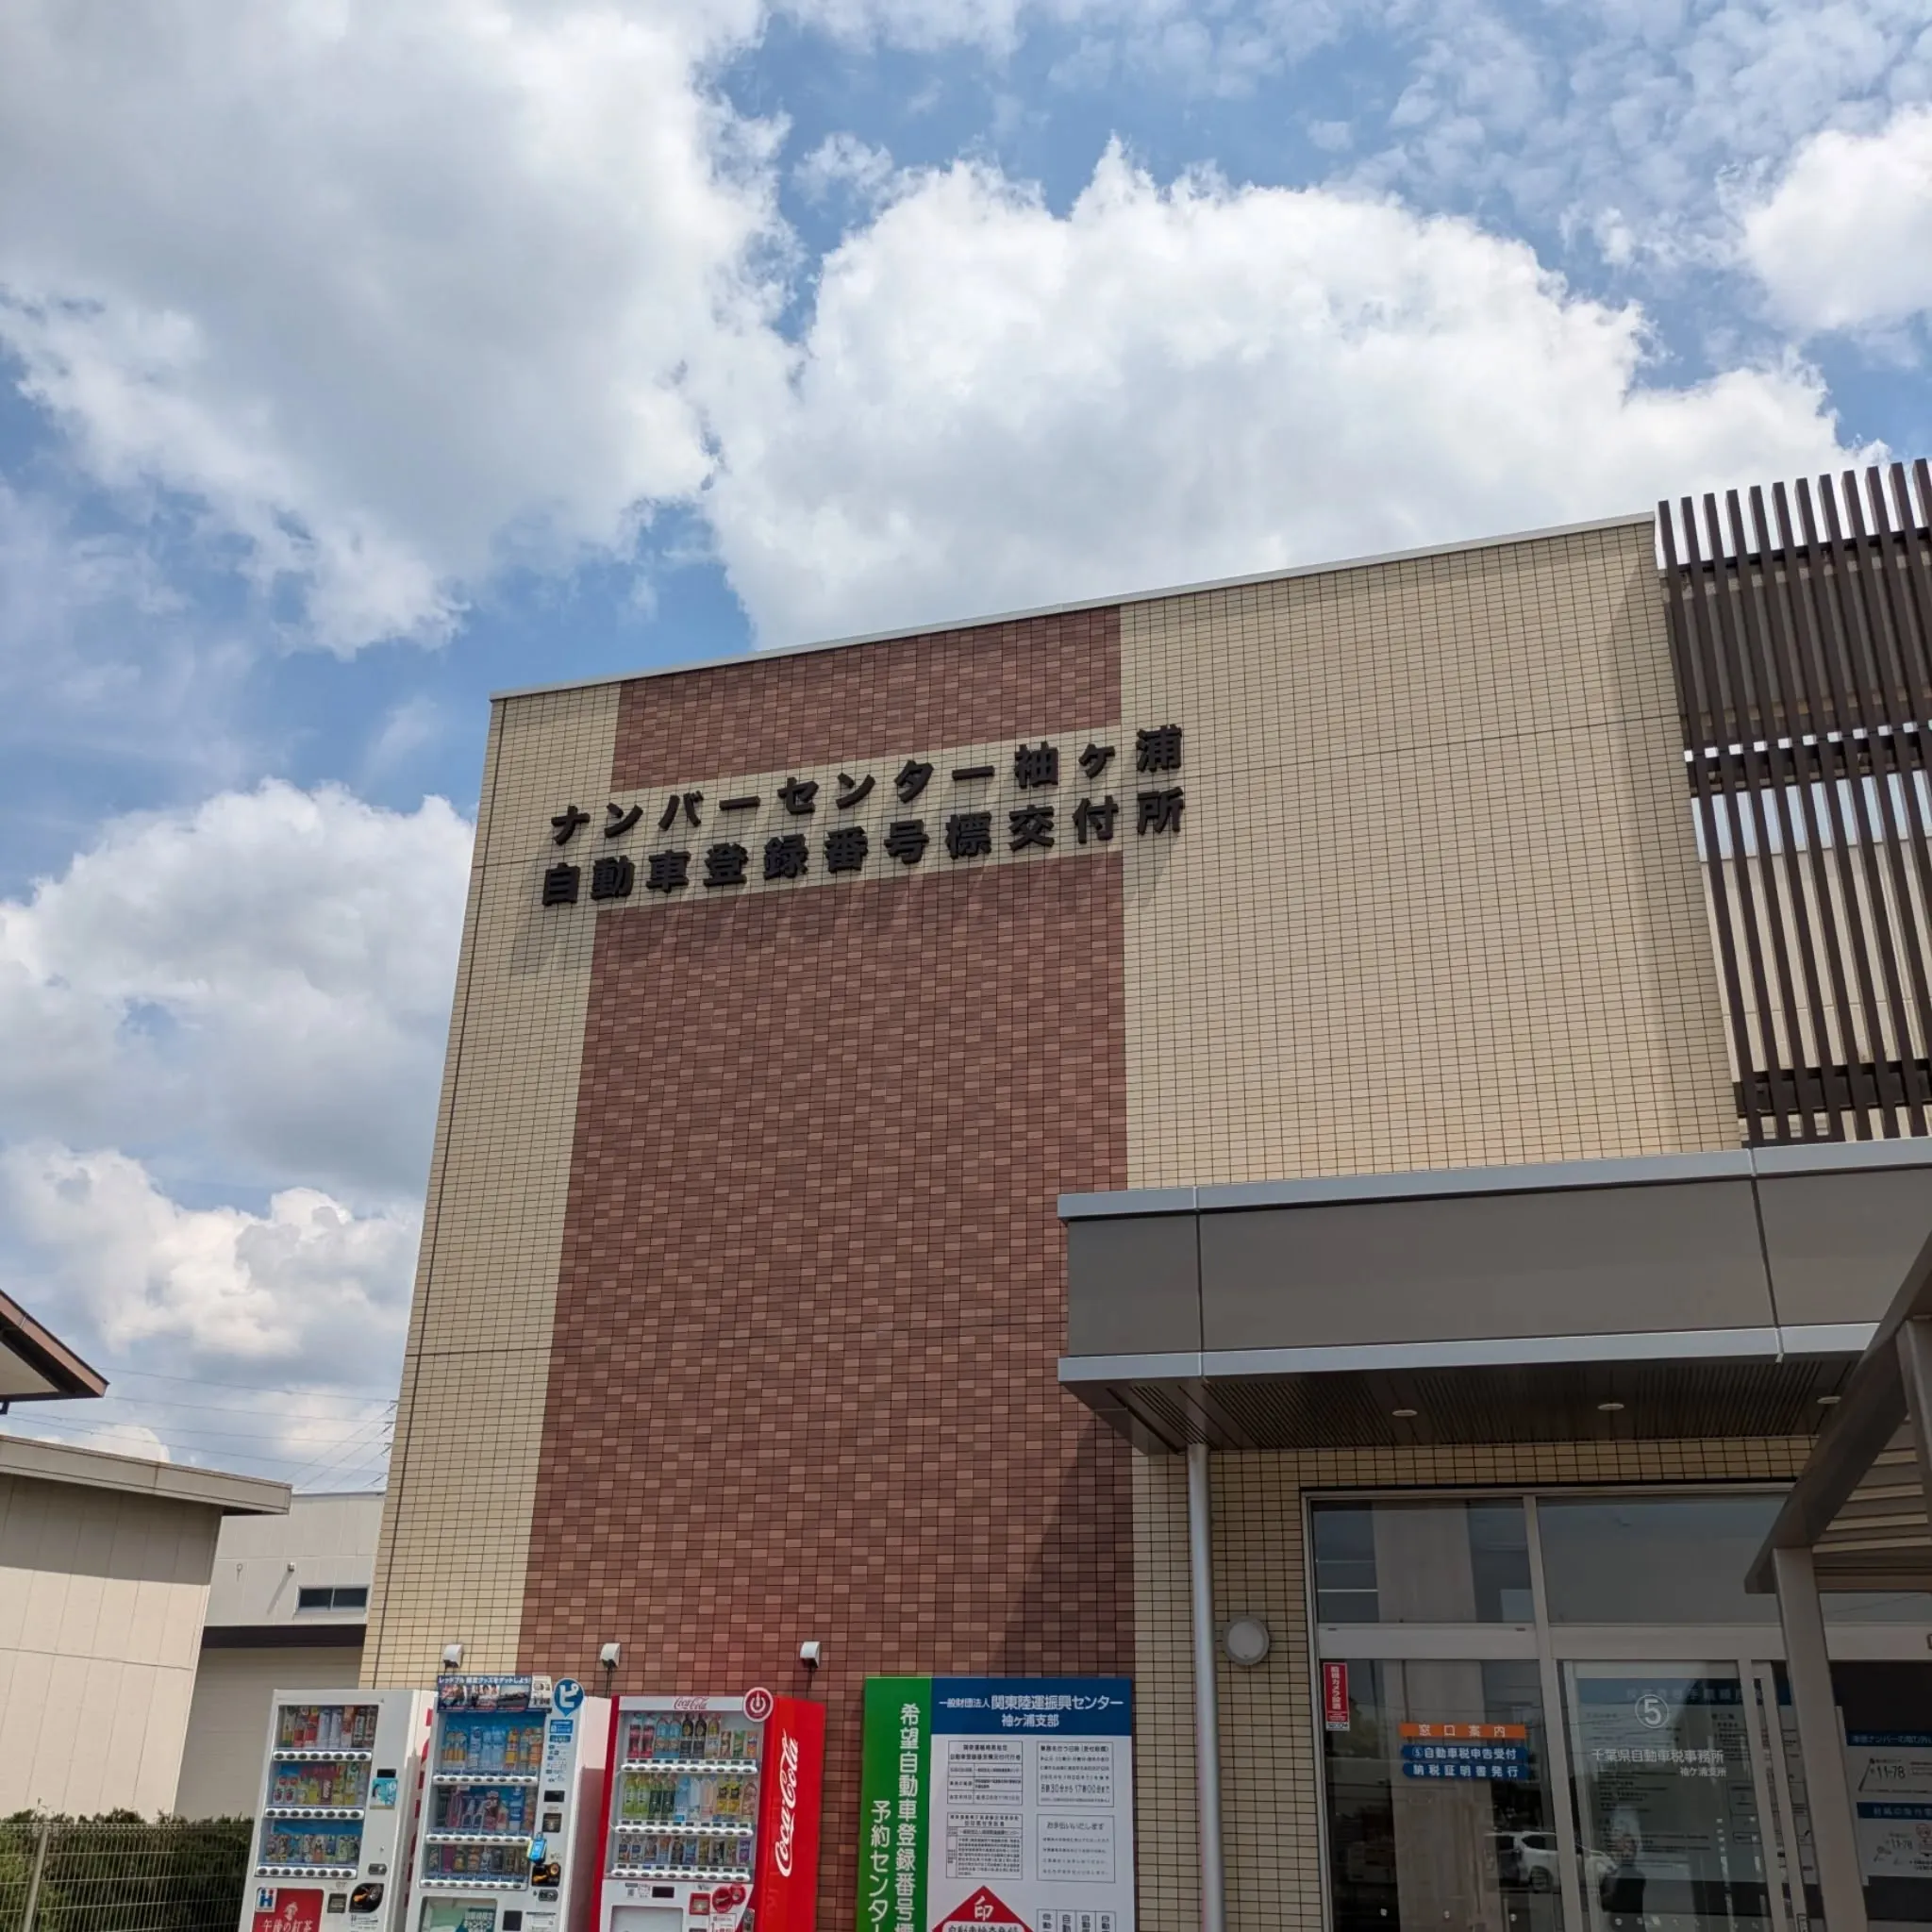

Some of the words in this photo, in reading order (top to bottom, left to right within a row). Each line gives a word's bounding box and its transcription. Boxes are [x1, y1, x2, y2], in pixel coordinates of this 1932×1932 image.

[542, 787, 1186, 907] 自動車登録番号標交付所
[674, 1697, 708, 1710] Coca-Cola
[1419, 1724, 1506, 1738] 窓口案内
[1591, 1748, 1724, 1763] 千葉県自動車税事務所
[1413, 1764, 1518, 1777] 納税証明書発行
[775, 1728, 799, 1877] Coca-Cola
[974, 1895, 994, 1922] 印
